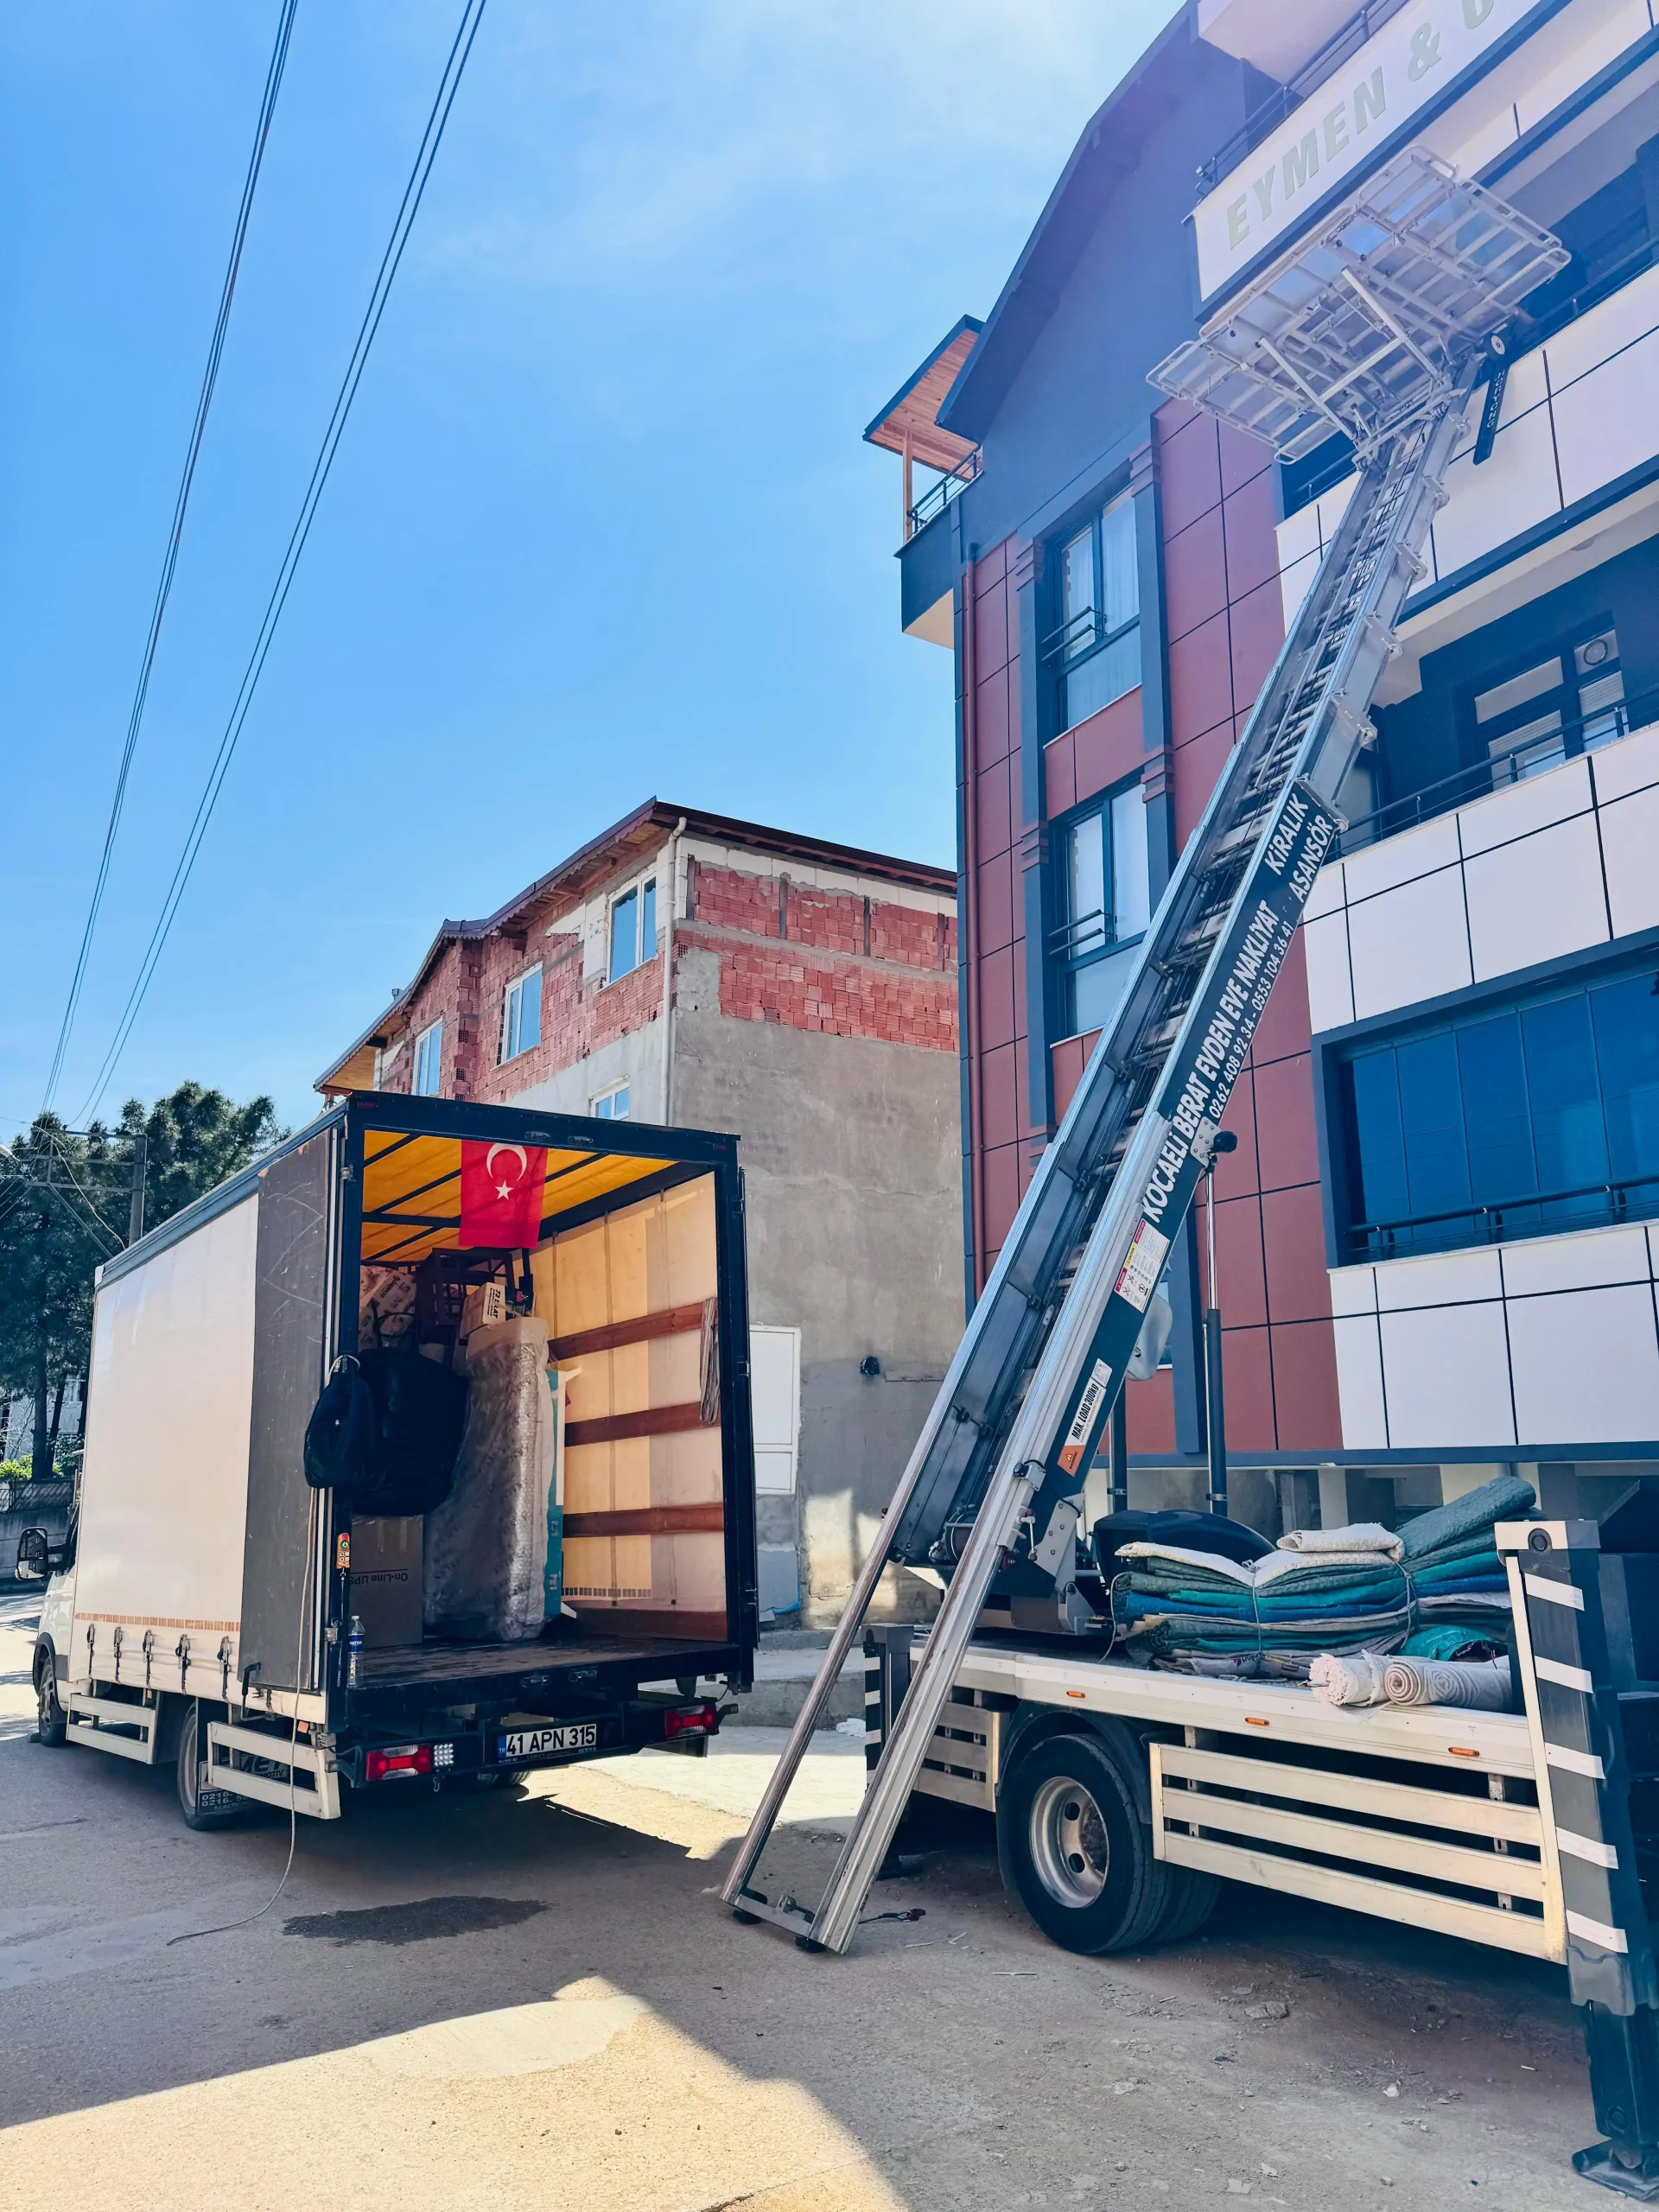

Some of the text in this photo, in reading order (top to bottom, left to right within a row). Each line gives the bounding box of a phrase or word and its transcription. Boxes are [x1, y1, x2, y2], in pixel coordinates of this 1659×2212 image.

[1227, 66, 1386, 251] EYMEN
[1408, 22, 1442, 81] &
[1264, 793, 1308, 876] KİRALIK
[1288, 815, 1333, 904] ASANSÖR
[1233, 899, 1279, 988] NAKLİYAT
[1209, 1083, 1230, 1119] 0262
[1223, 1055, 1241, 1084] 408
[1233, 1037, 1249, 1057] 92
[1241, 1018, 1255, 1037] 34
[1251, 977, 1272, 1012] 0553
[1264, 953, 1281, 979] 104
[1274, 936, 1287, 956] 36
[1281, 920, 1294, 938] 41
[1219, 978, 1249, 1021] EVE
[1195, 1011, 1236, 1082] EVDEN
[1173, 1071, 1211, 1141] BERAT
[1143, 1130, 1190, 1224] KOCAELİ
[495, 1289, 501, 1299] 72
[1071, 1383, 1099, 1440] MAX. LOAD 300kg
[372, 1573, 408, 1583] On-Line
[506, 1734, 524, 1755] 41
[529, 1729, 565, 1752] APN
[569, 1726, 595, 1746] 315
